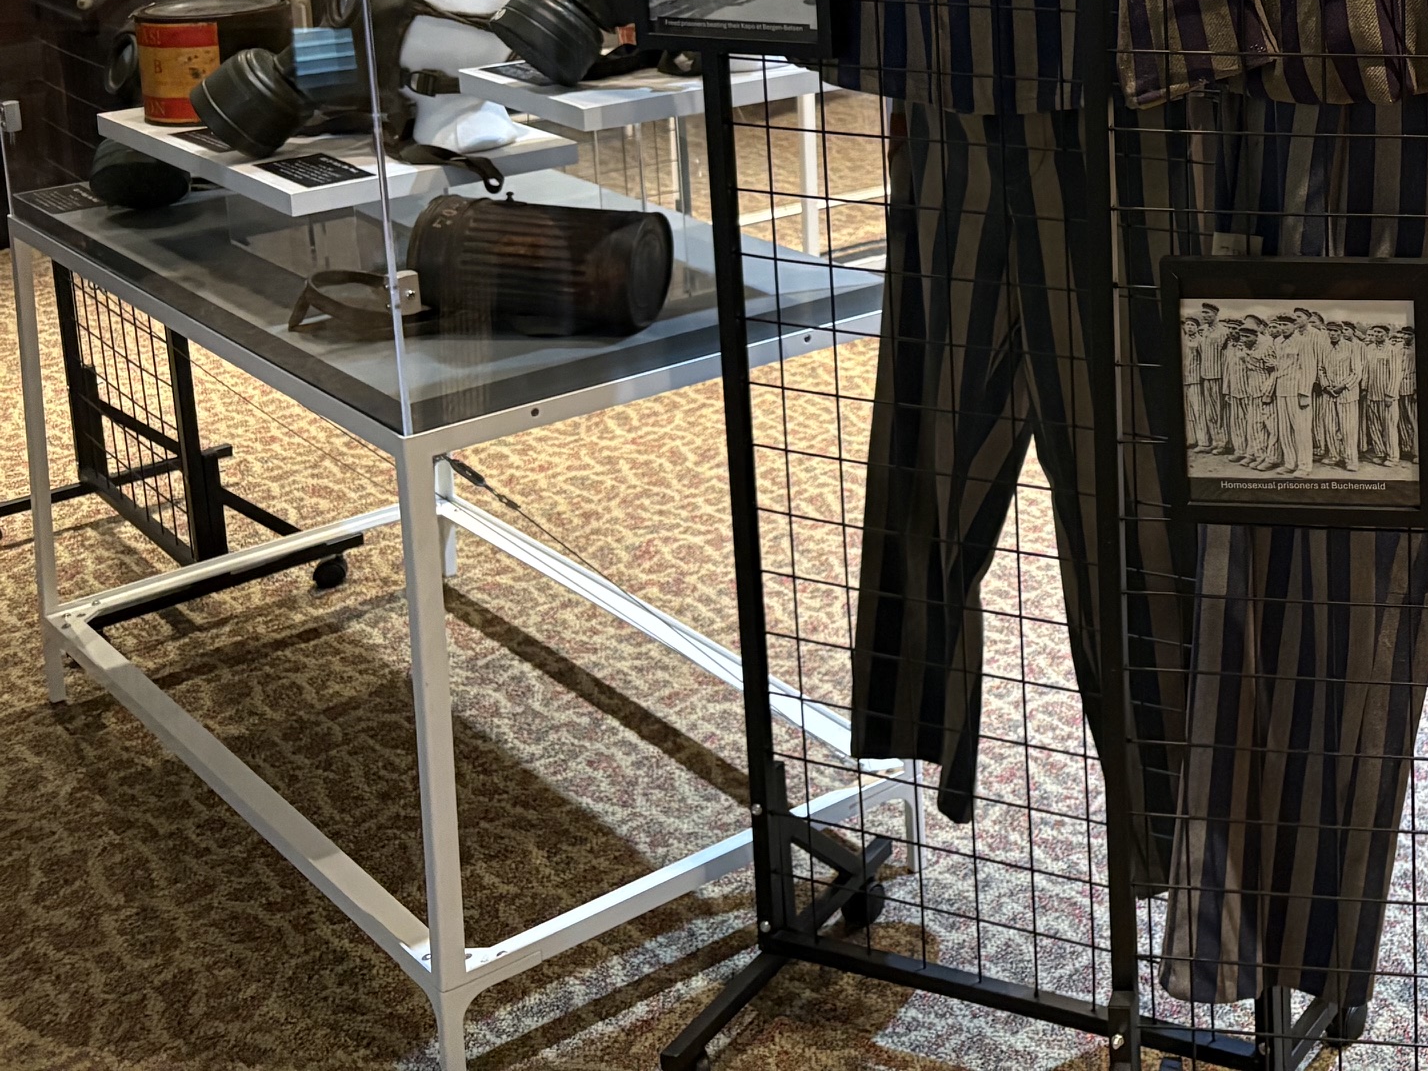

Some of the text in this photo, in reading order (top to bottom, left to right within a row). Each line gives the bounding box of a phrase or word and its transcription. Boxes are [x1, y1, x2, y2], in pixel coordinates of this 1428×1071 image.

[741, 23, 755, 31] Kapo
[763, 24, 804, 32] Bergen-Belsen
[154, 59, 162, 74] B
[1220, 481, 1276, 489] Homosexual
[1277, 481, 1318, 490] prisoners
[1331, 482, 1386, 490] Buchenwald
